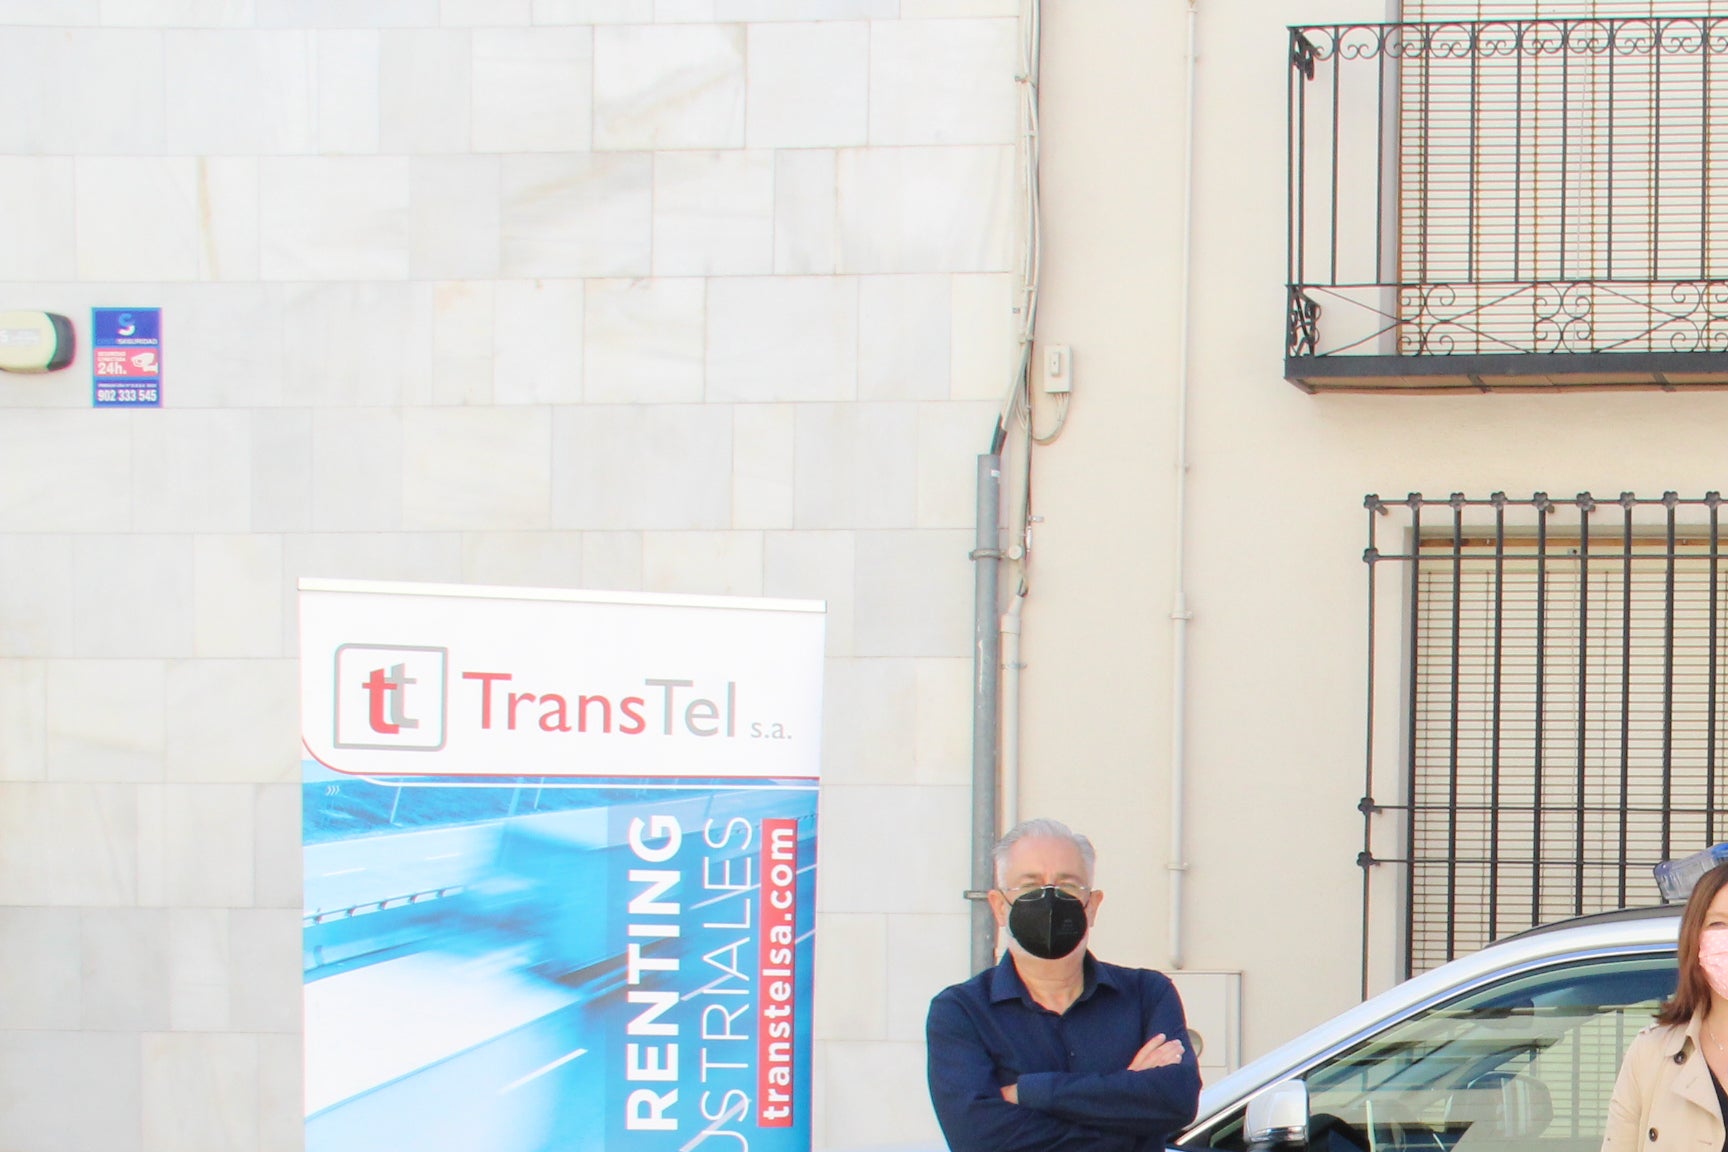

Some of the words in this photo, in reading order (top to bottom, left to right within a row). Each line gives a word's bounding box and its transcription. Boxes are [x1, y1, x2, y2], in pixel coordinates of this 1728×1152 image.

[97, 362, 127, 375] 24h.
[97, 389, 116, 402] 902
[118, 389, 136, 402] 333
[138, 389, 157, 402] 545
[462, 671, 736, 738] TransTel
[750, 720, 793, 741] s.a.
[626, 814, 682, 1131] RENTING
[762, 827, 794, 1120] transtelsa.com
